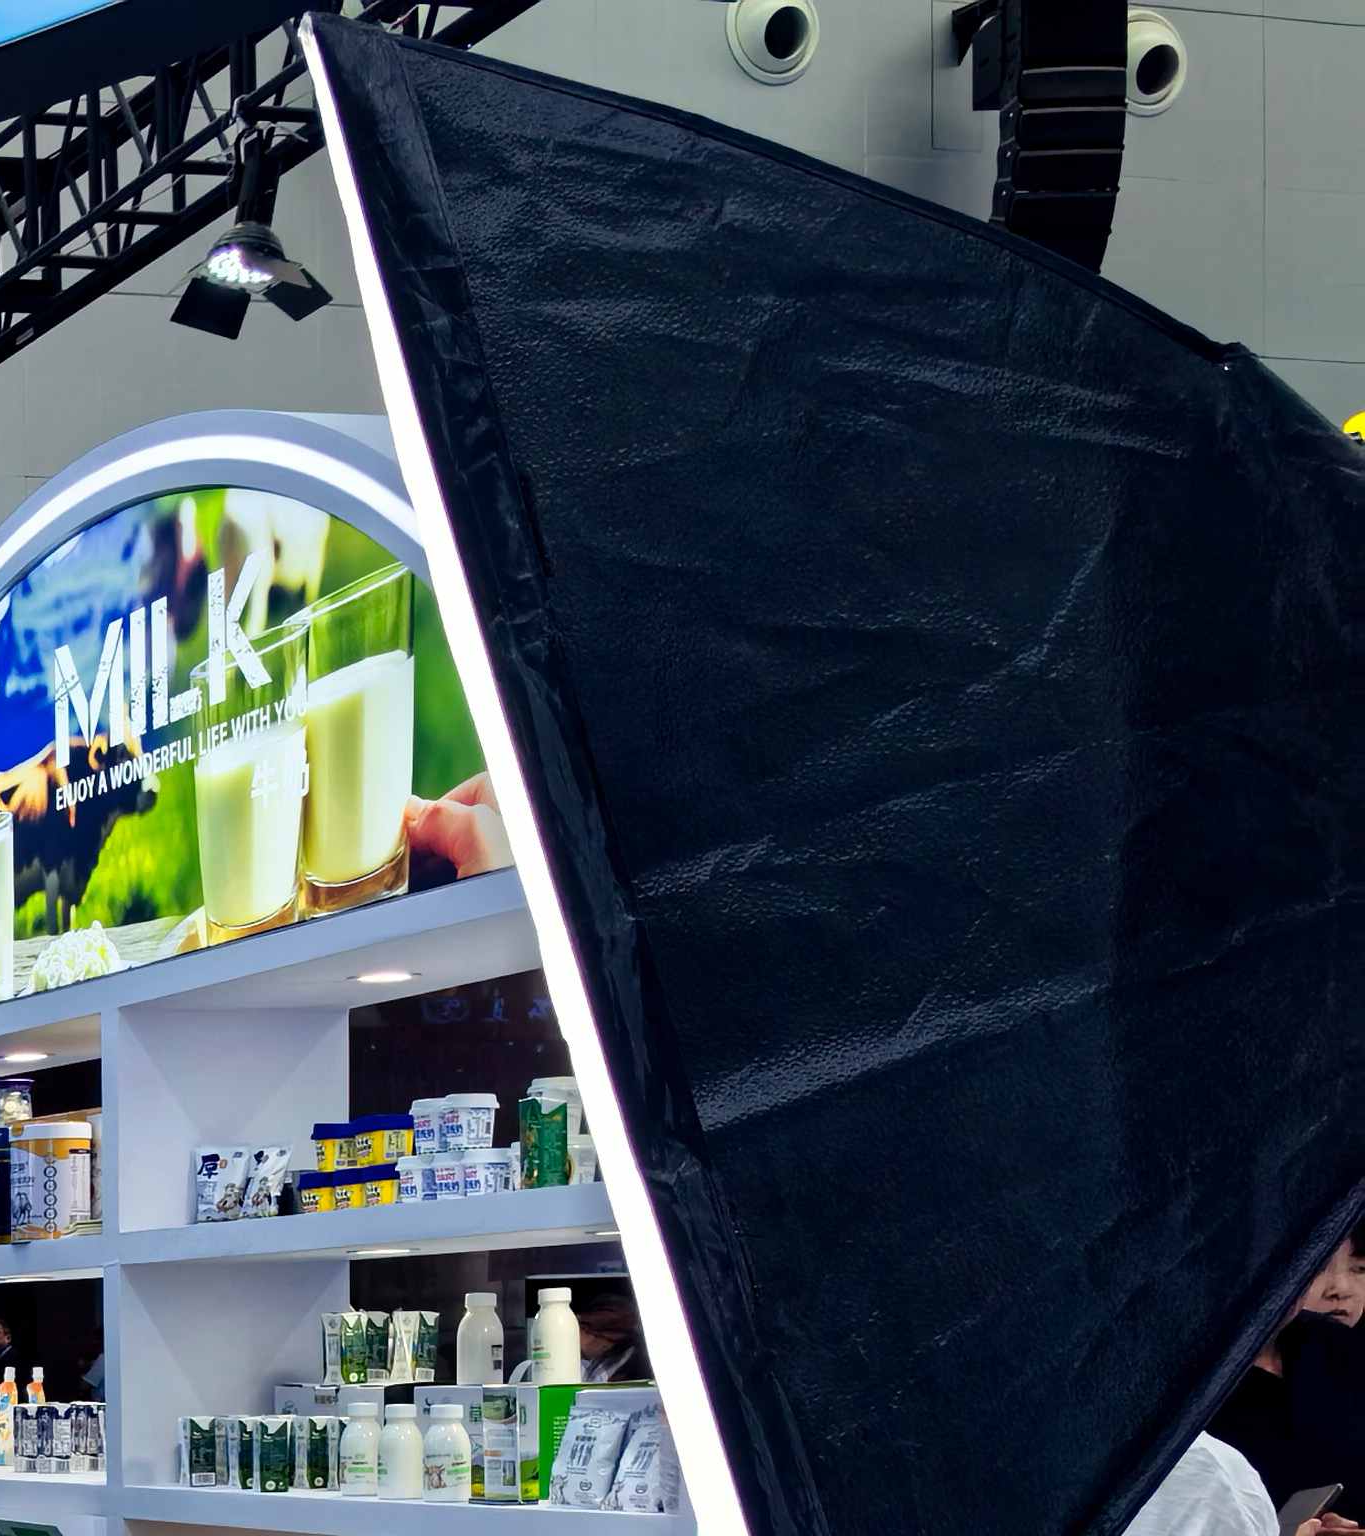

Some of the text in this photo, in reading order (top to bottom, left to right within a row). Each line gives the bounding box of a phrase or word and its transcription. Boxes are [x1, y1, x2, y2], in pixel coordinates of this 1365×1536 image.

[54, 551, 272, 770] MILK
[56, 774, 96, 811] ENJOY
[98, 770, 108, 796] A
[110, 736, 195, 789] WONDERFUL
[198, 722, 229, 756] LIFE
[231, 707, 271, 741] WITH
